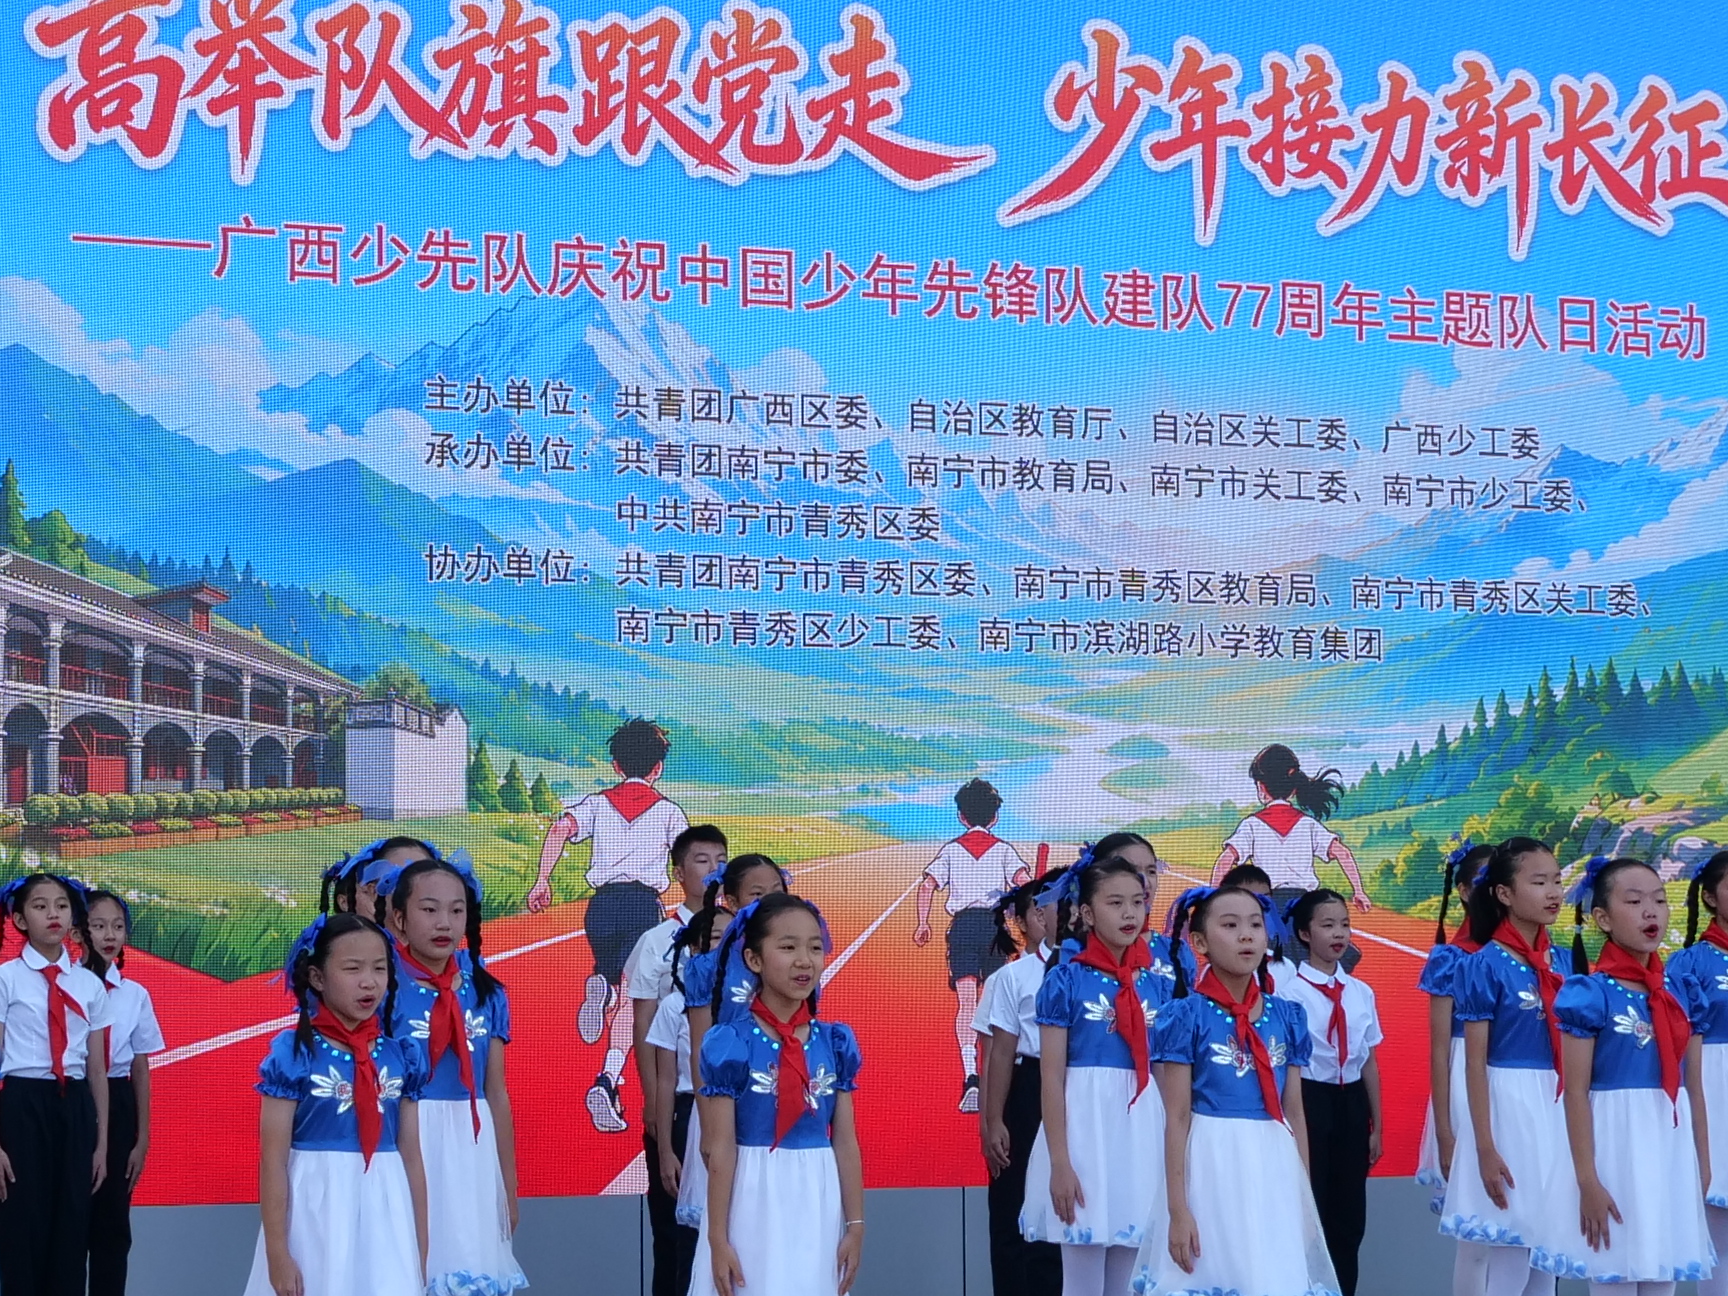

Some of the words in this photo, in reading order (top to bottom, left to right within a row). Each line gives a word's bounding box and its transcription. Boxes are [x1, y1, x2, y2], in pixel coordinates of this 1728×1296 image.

[615, 496, 941, 543] 中共南宁市青秀区委
[615, 606, 1384, 664] 南宁市青秀区少工委、南宁市滨湖路小学教育集团
